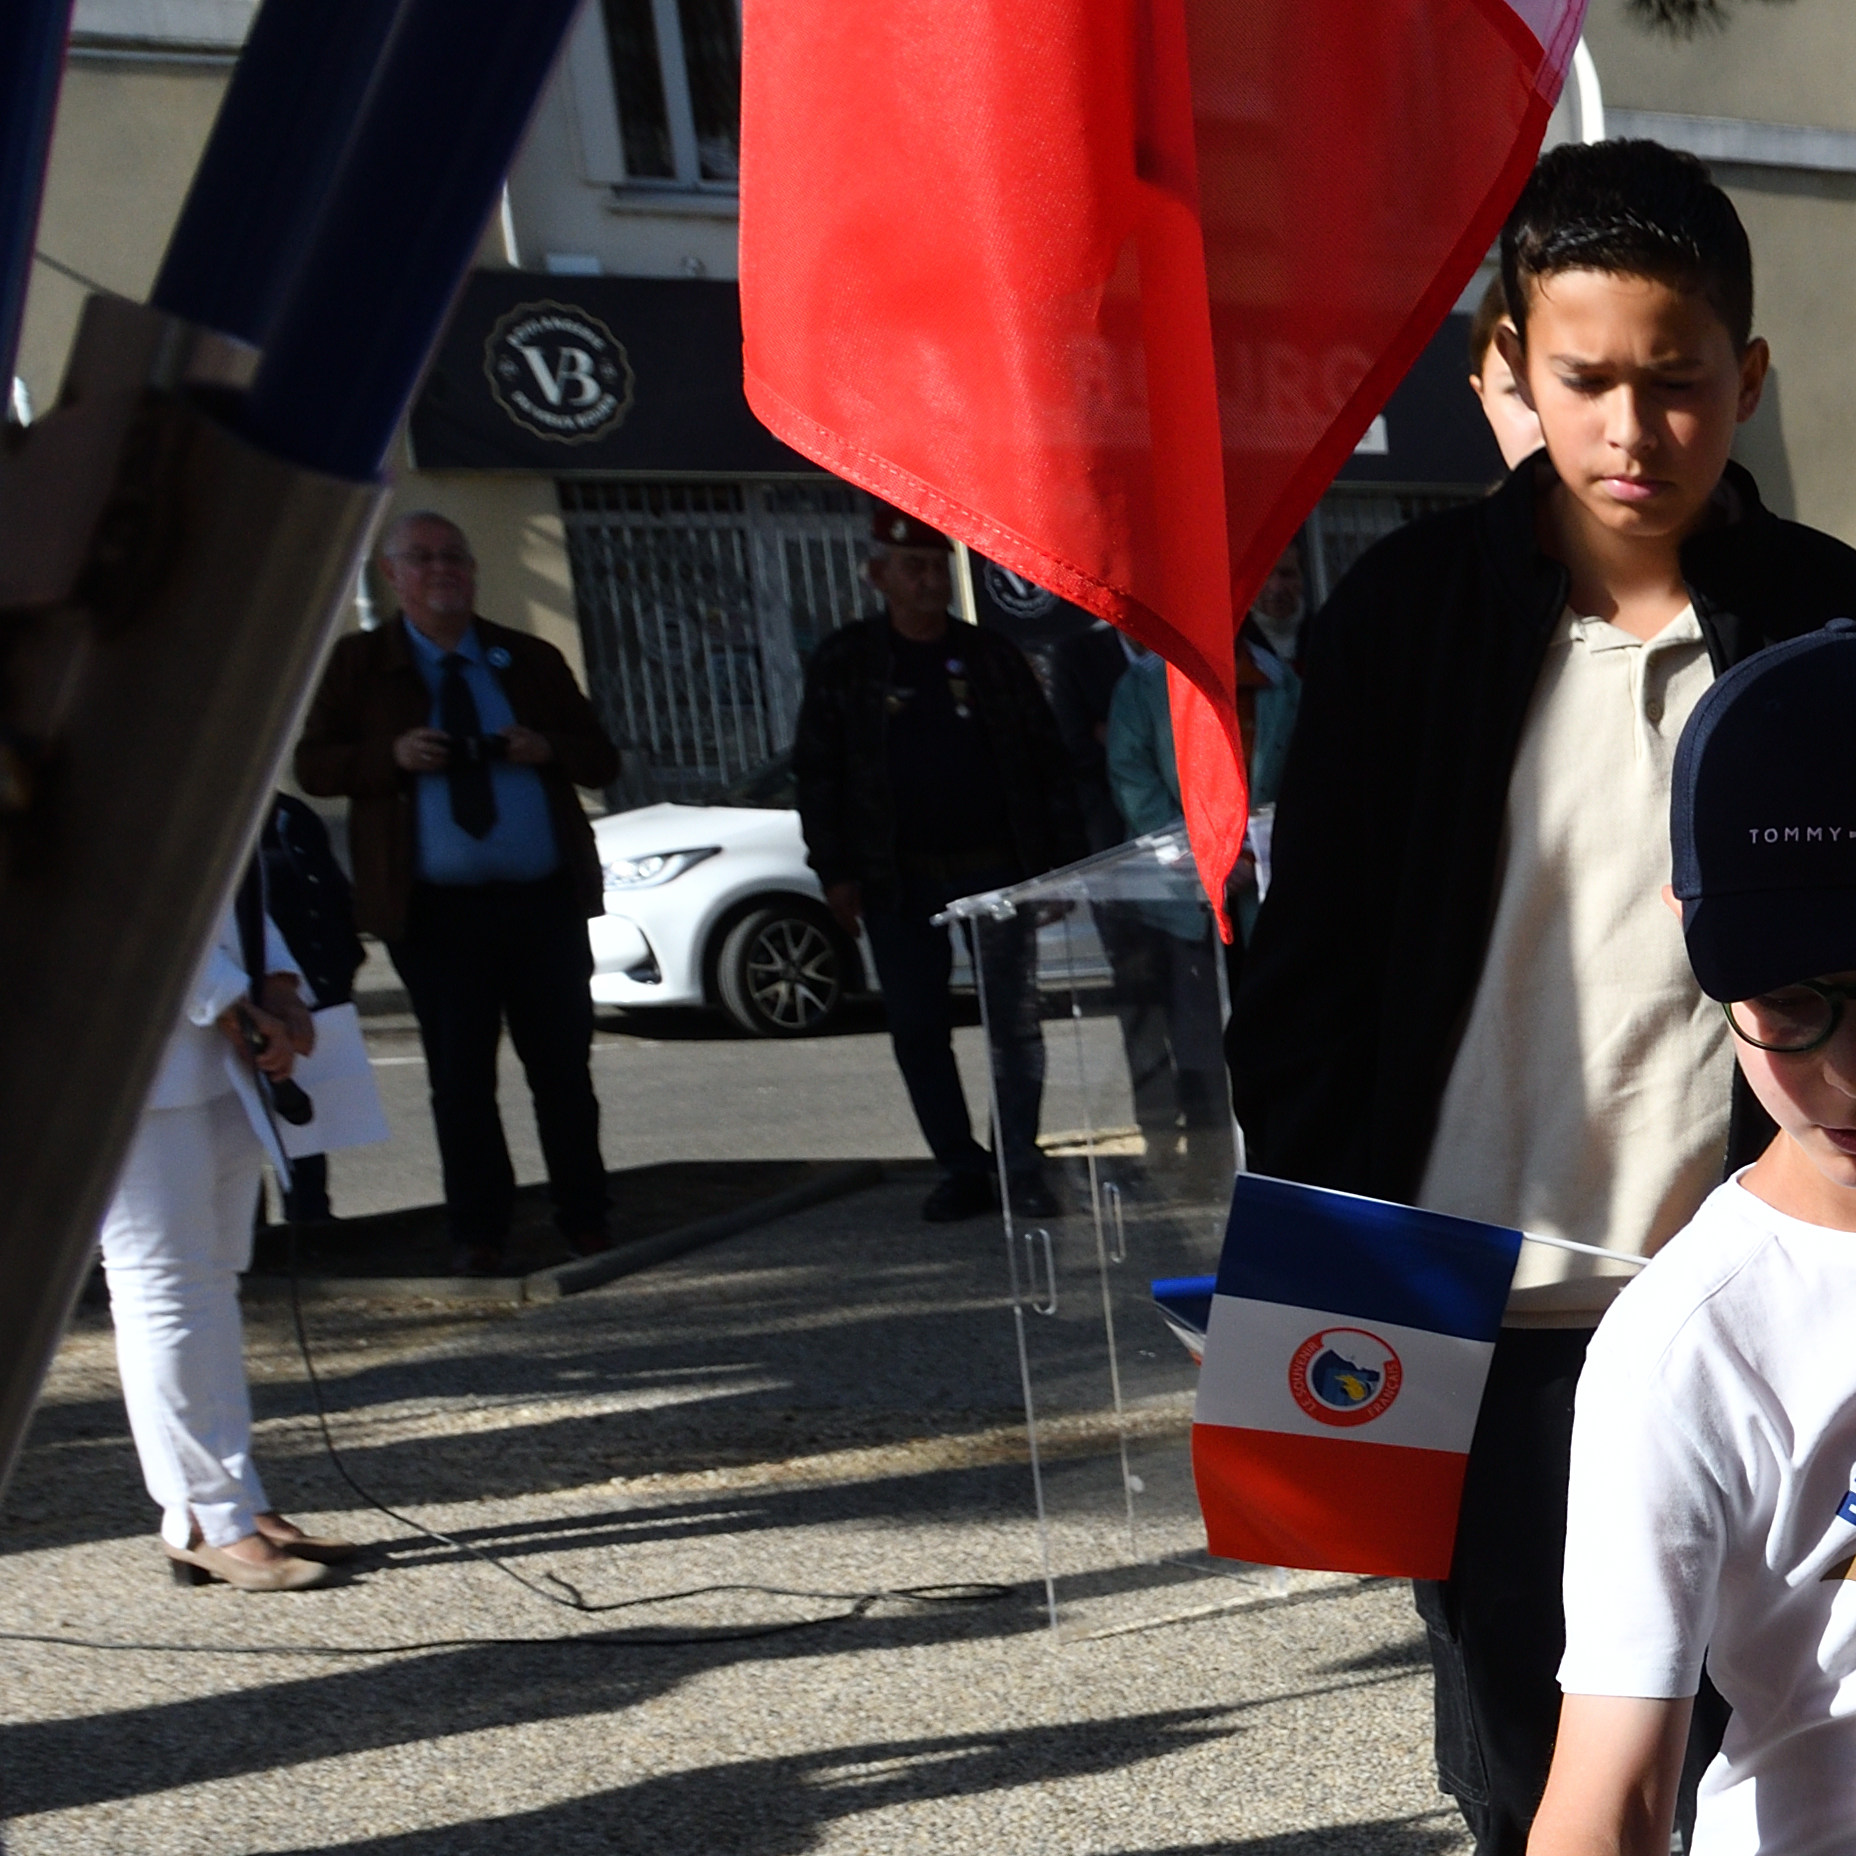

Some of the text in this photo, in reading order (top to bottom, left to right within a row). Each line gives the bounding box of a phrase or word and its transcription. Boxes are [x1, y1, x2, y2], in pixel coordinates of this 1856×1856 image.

[519, 346, 601, 407] VB
[1749, 827, 1842, 844] TOMMY
[1292, 1341, 1317, 1397] SOUVENIR
[1299, 1397, 1317, 1412] LE
